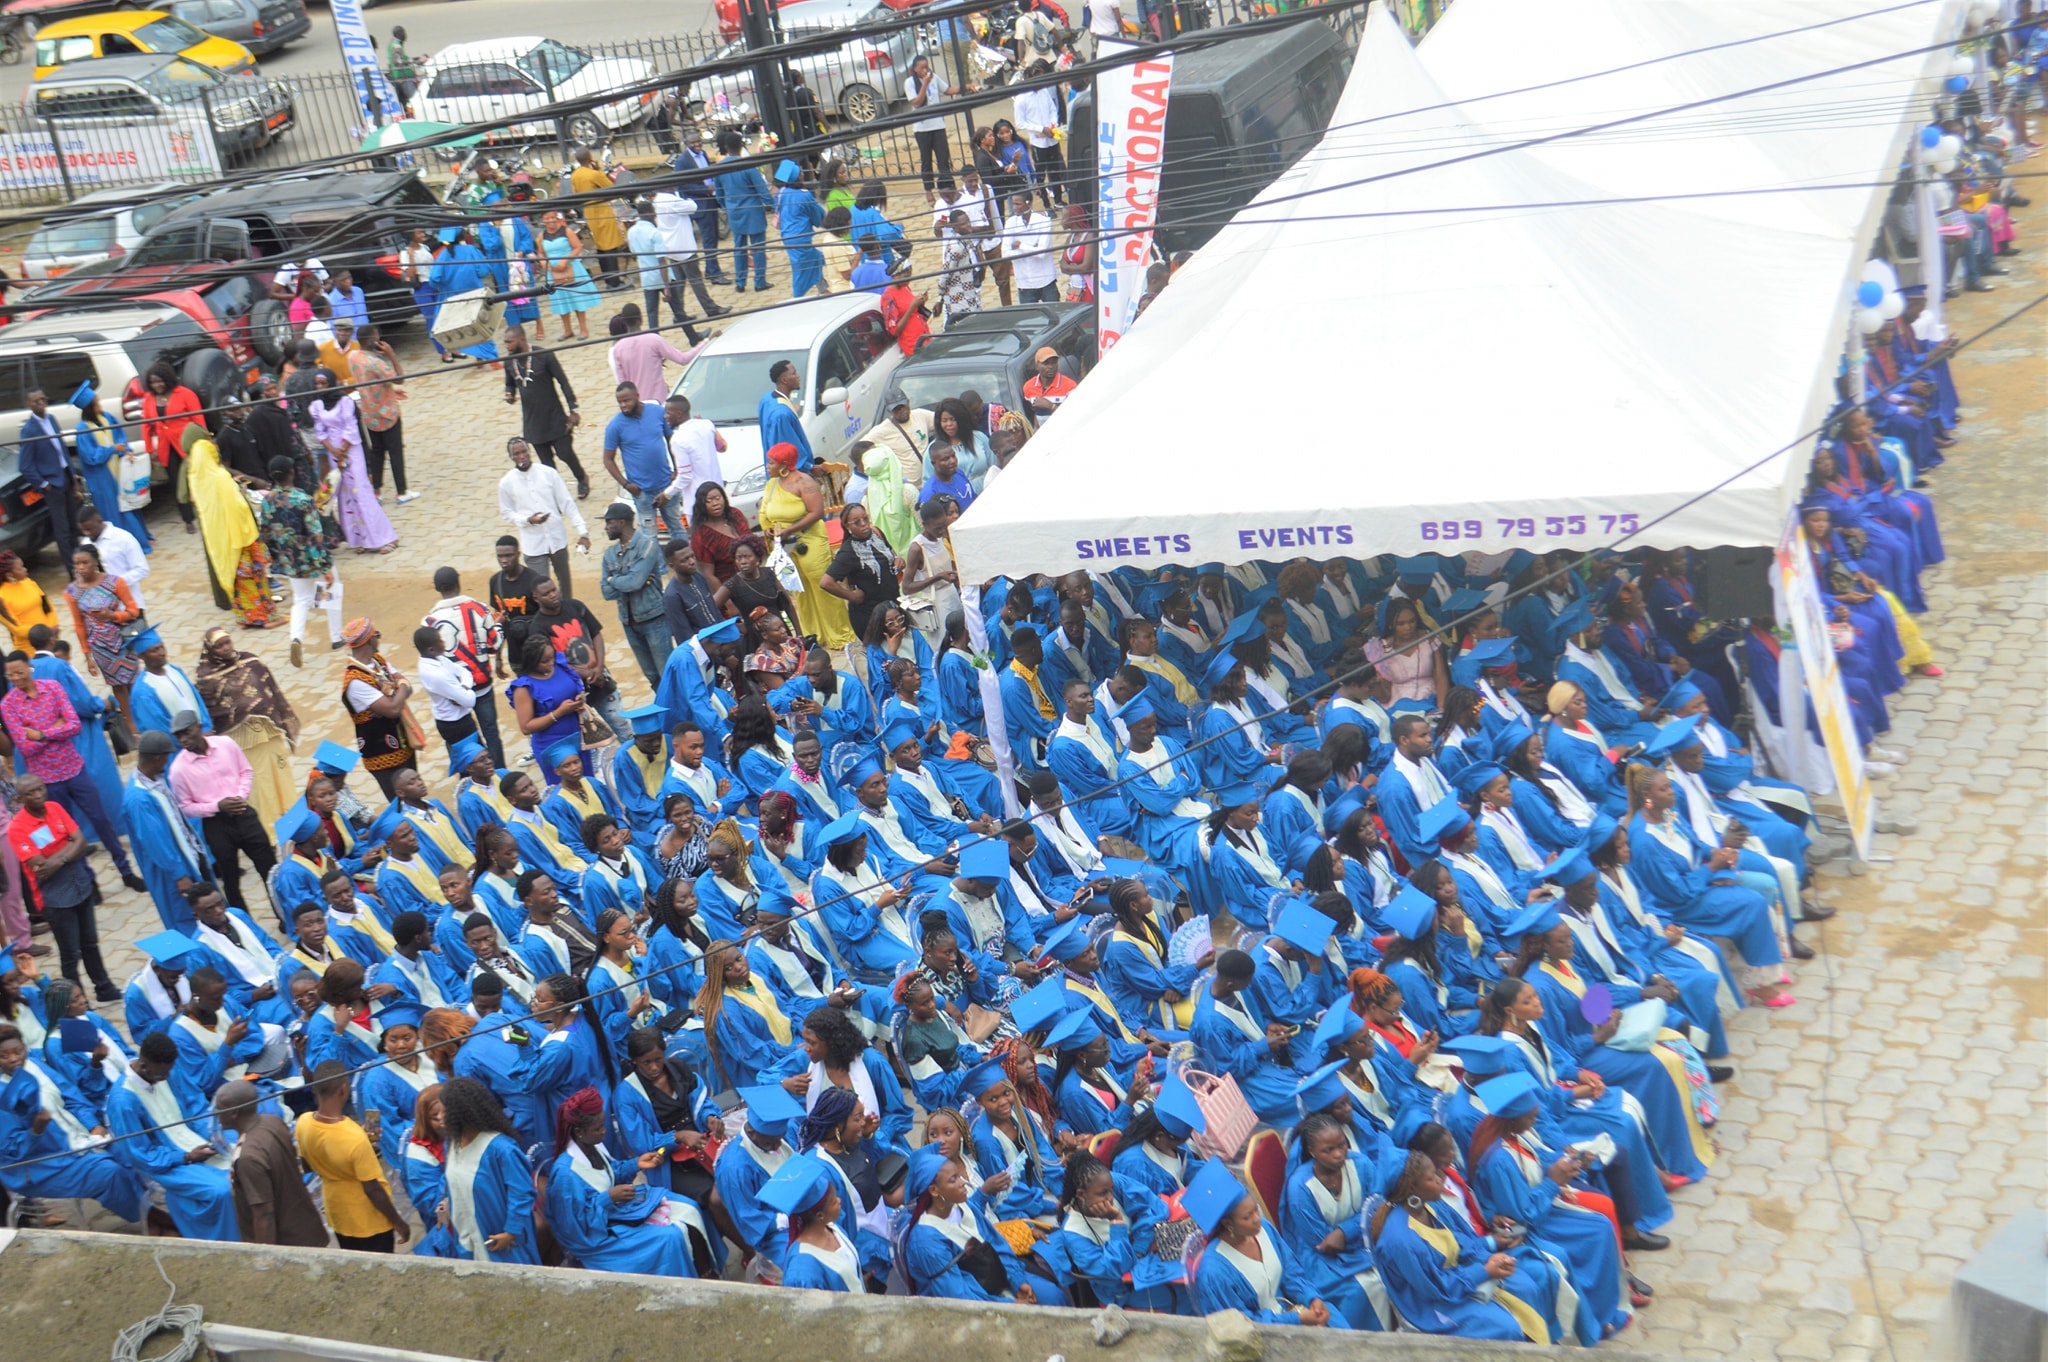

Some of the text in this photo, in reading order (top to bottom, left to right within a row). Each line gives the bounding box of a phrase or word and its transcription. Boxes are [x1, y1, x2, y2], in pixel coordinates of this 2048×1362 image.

[16, 150, 137, 170] BOMEDICALES
[1076, 514, 1638, 559] SWEETS EVENTS 699 79 55 75
